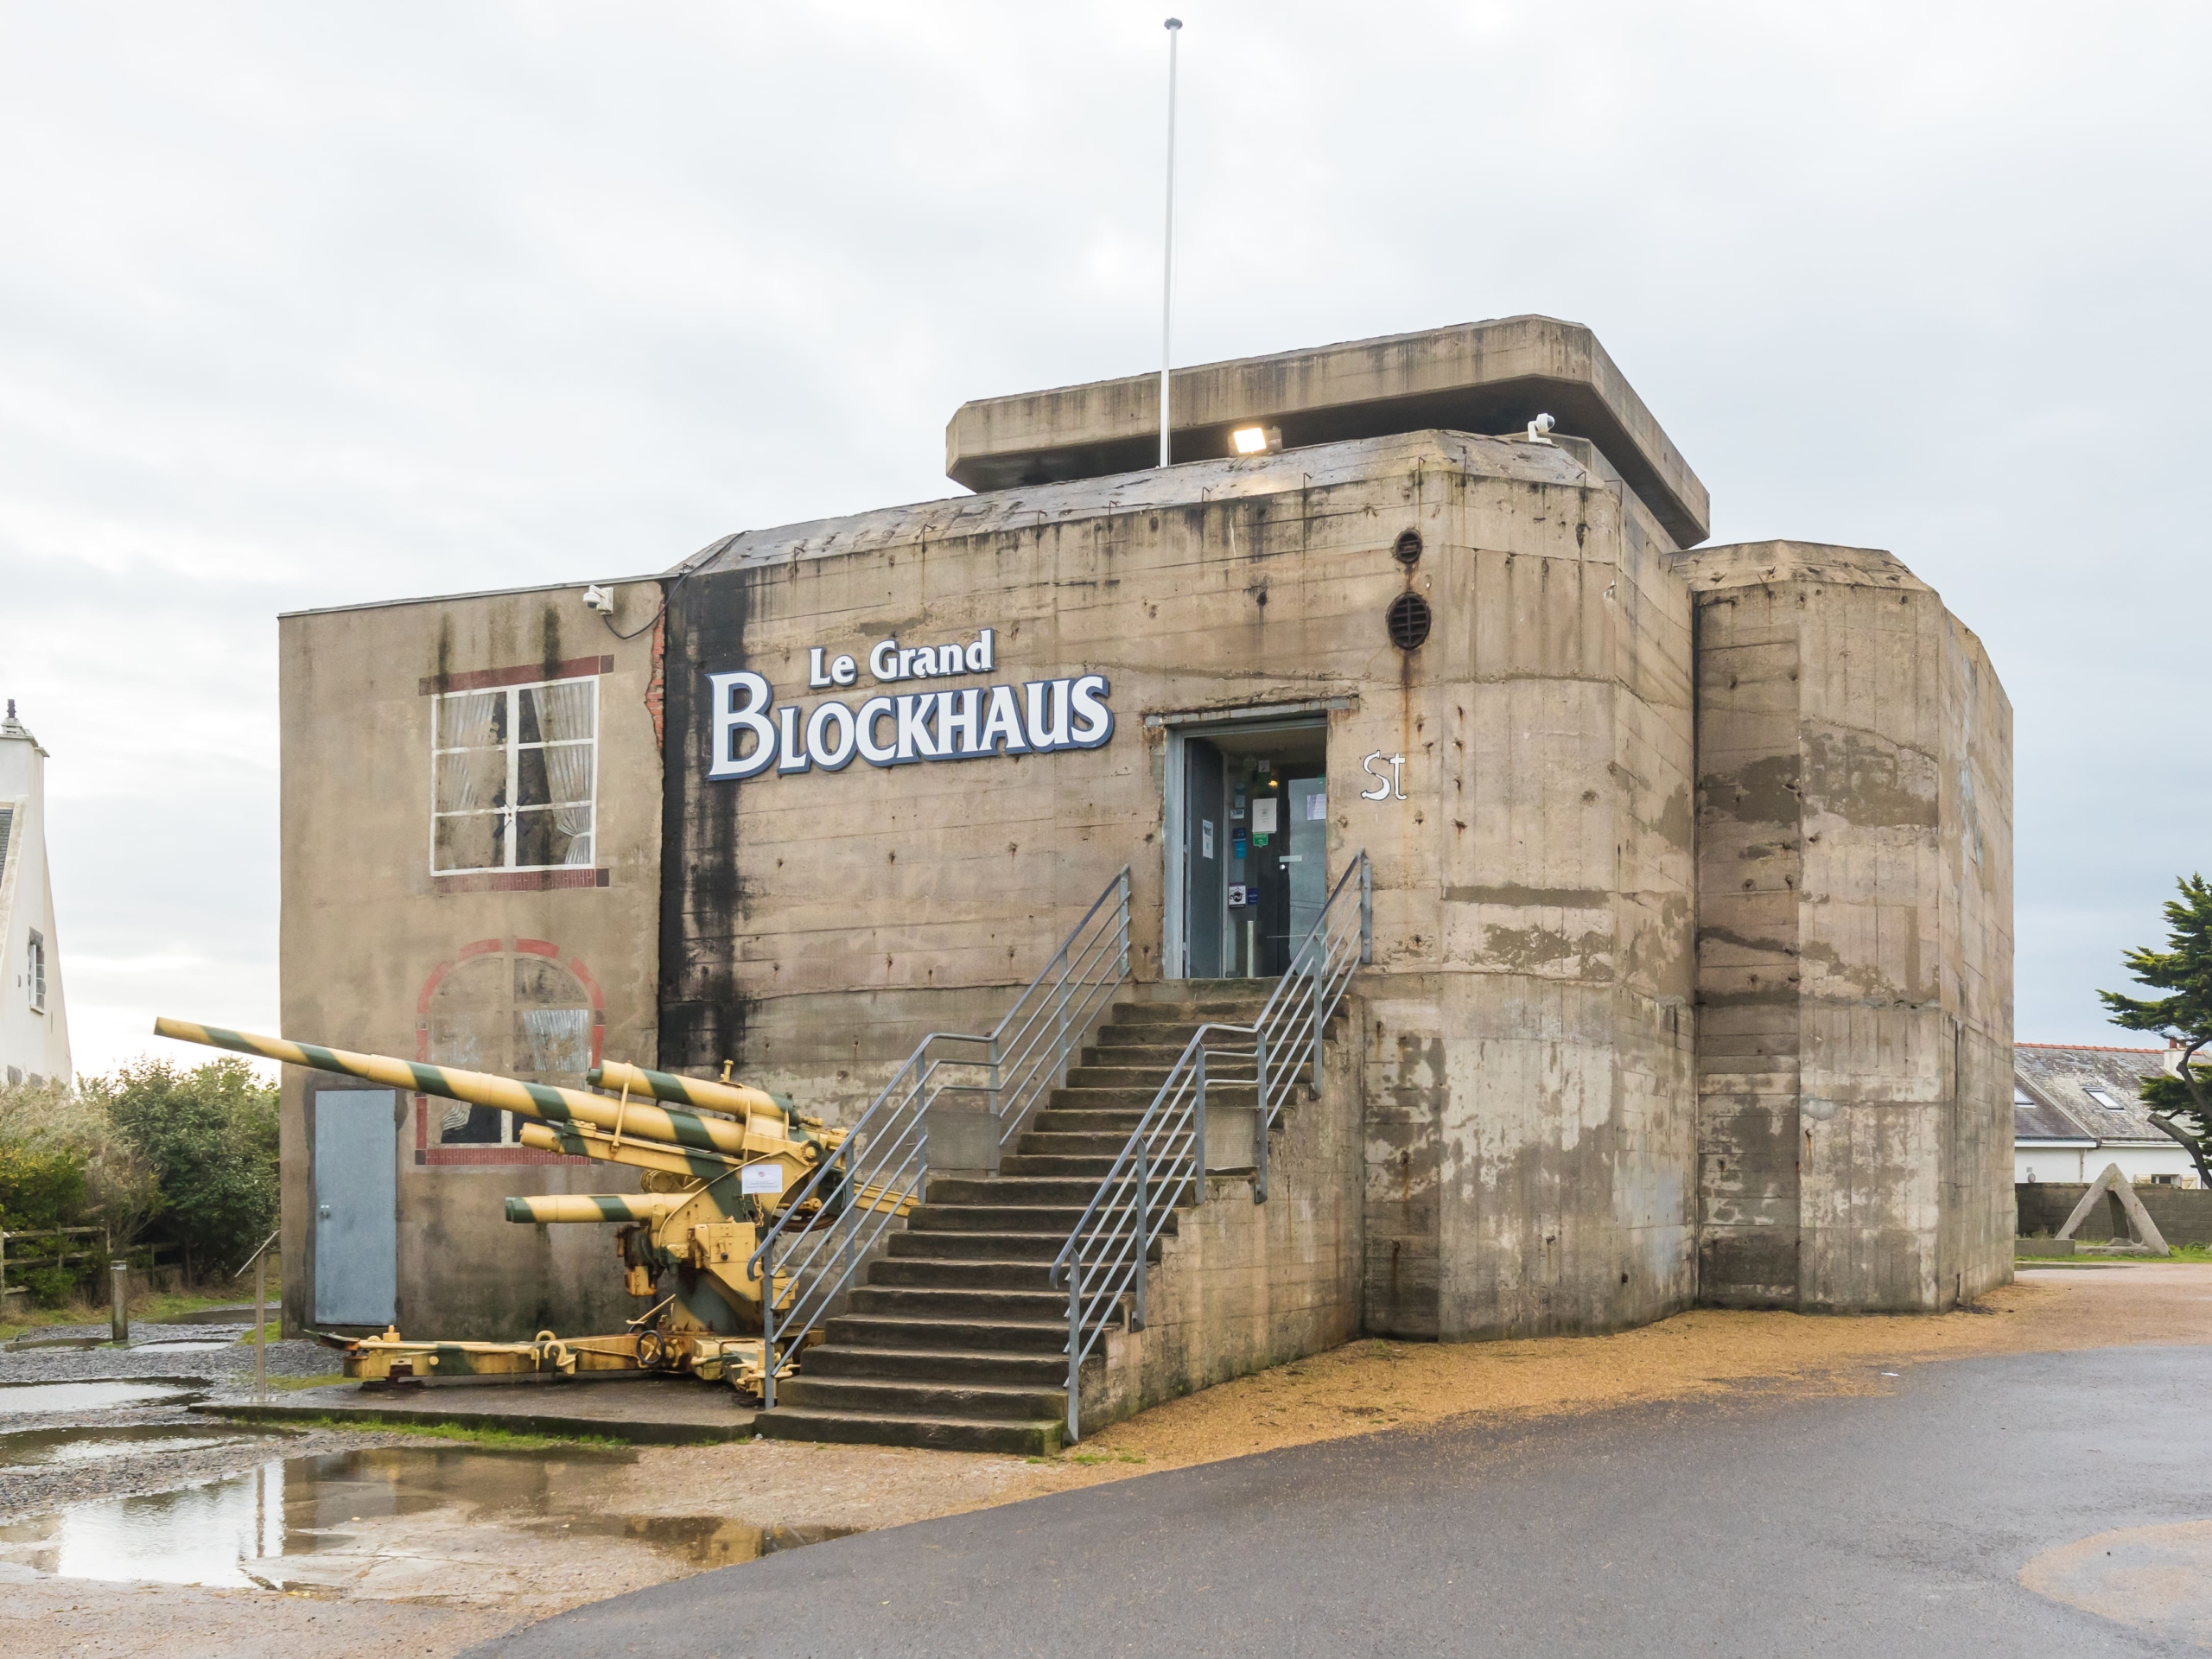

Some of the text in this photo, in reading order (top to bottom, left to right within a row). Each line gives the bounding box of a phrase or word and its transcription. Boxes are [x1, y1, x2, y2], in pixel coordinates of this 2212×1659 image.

[810, 628, 995, 688] Le Grand
[706, 671, 1114, 780] BLOCKHAUS
[1360, 749, 1408, 801] St
